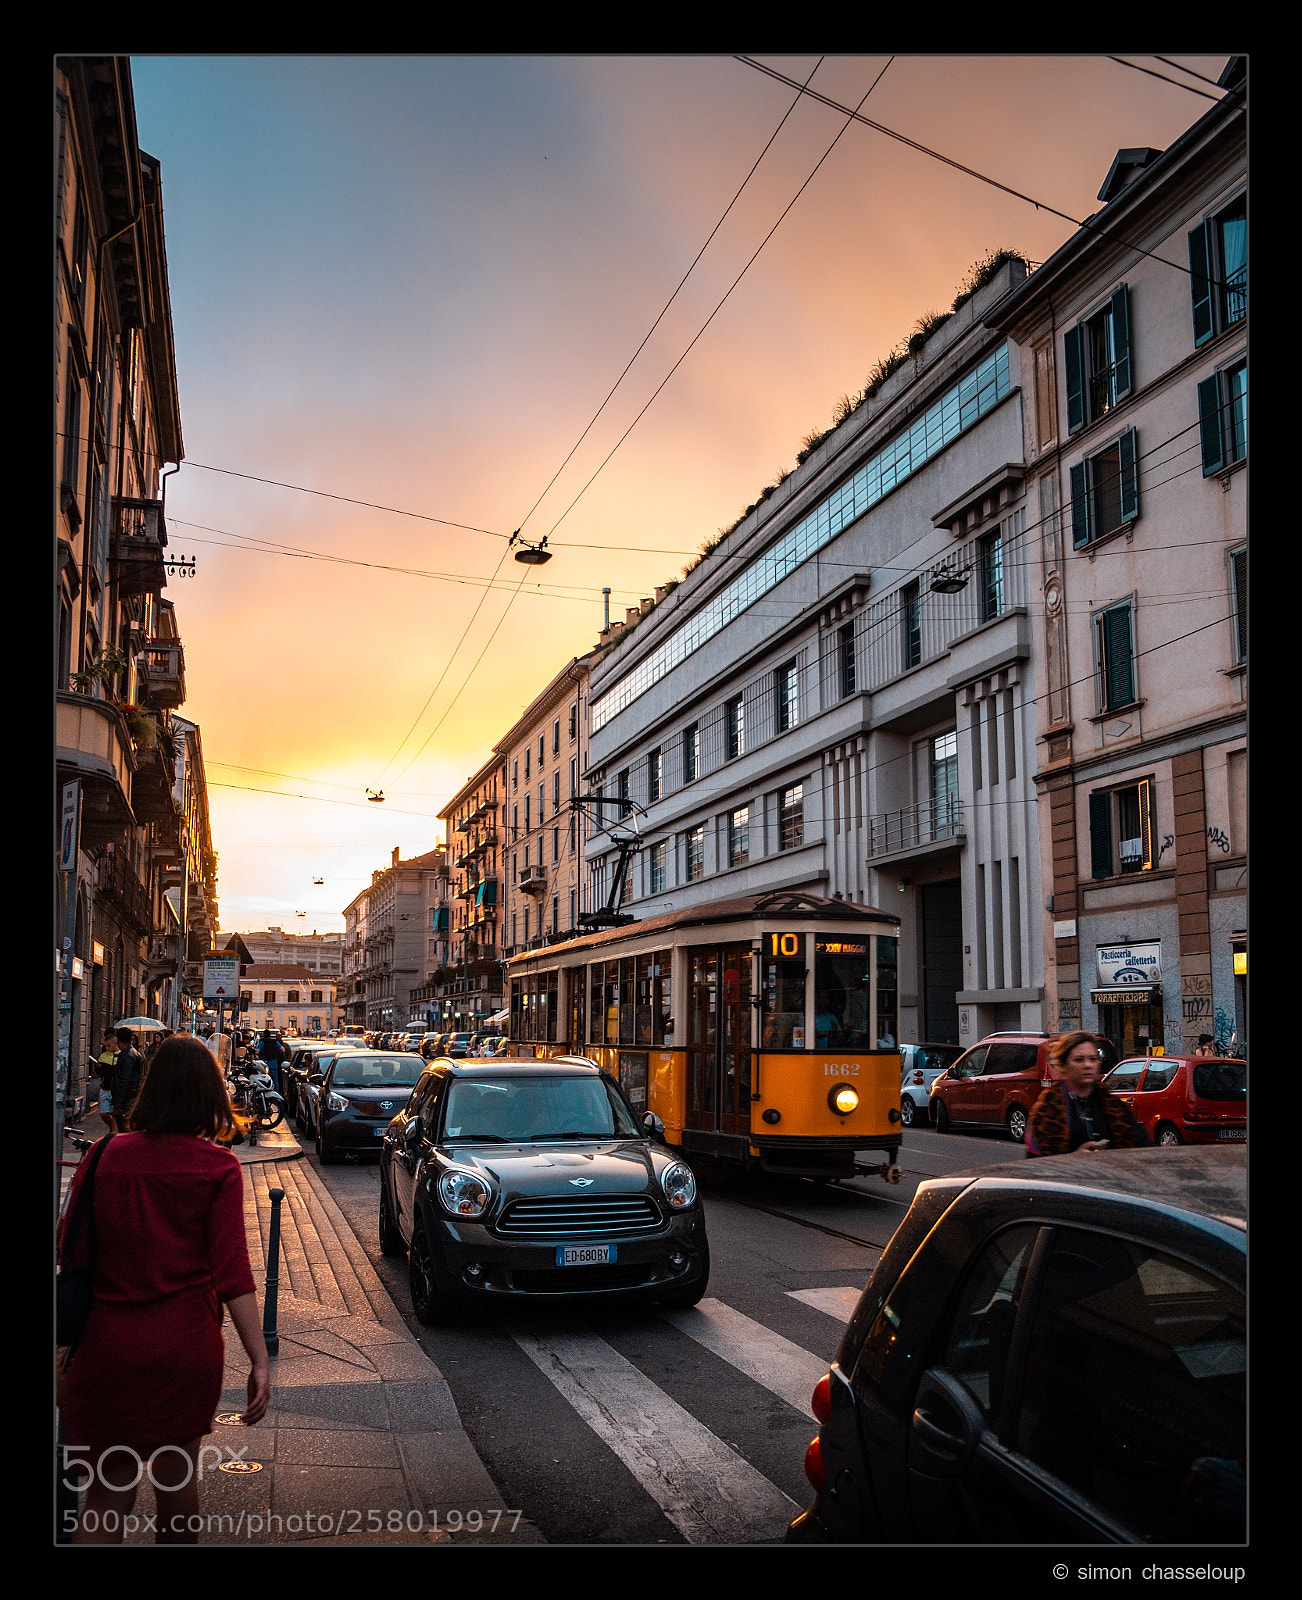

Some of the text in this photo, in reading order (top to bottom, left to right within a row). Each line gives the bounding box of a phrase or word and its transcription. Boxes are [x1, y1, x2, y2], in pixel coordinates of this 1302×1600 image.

[771, 933, 798, 956] 10
[1101, 949, 1132, 960] Pasticceria
[1125, 955, 1157, 966] caffetteria
[824, 1063, 861, 1076] 1662
